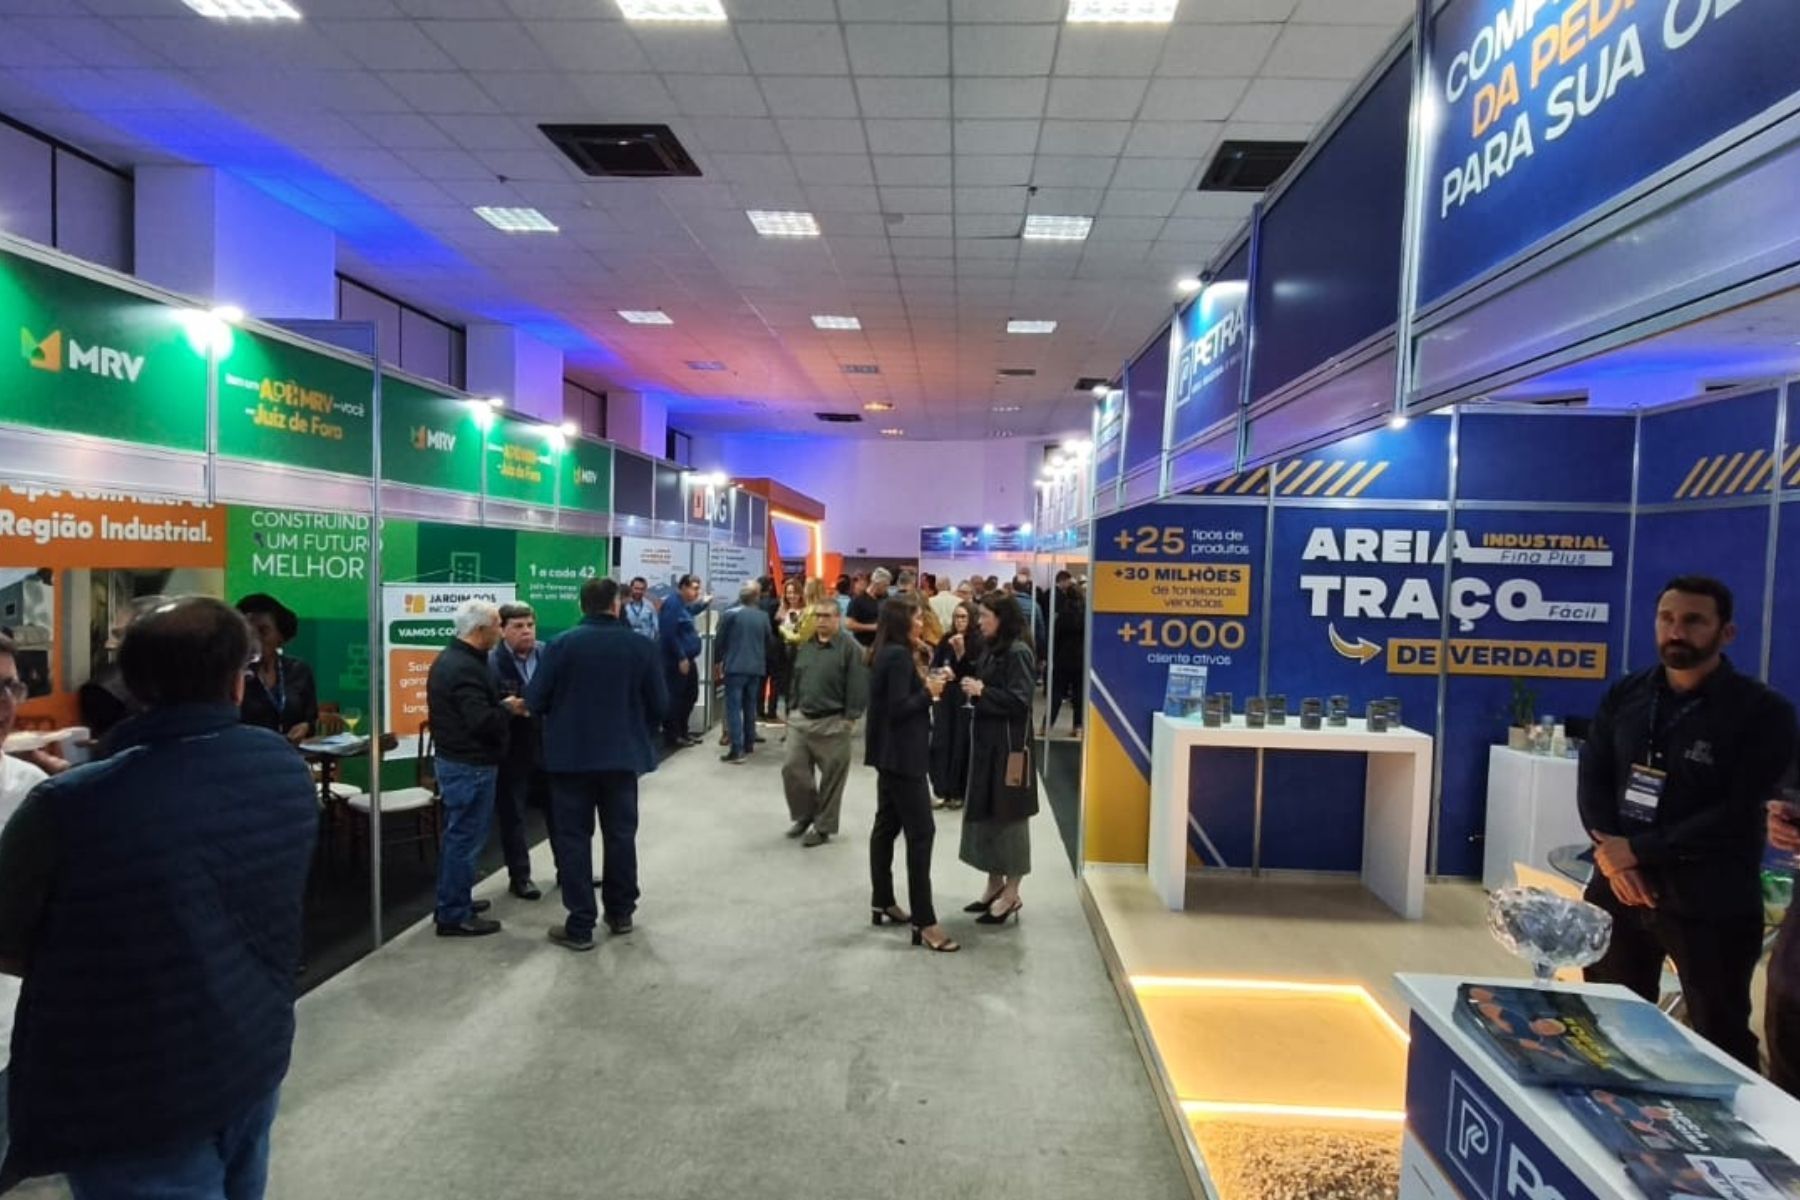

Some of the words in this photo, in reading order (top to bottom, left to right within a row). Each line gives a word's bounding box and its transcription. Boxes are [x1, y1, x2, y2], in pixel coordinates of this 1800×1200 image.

[1472, 61, 1520, 138] DA
[1441, 110, 1534, 218] PARA
[1545, 23, 1645, 141] SUA
[69, 339, 145, 382] MRV
[288, 411, 308, 433] de
[310, 415, 343, 439] Fora
[427, 429, 456, 451] MRV
[0, 508, 94, 544] Região
[100, 514, 213, 543] Industrial.
[266, 533, 299, 550] UM
[1114, 526, 1185, 555] +25
[1225, 529, 1244, 541] de
[1191, 543, 1249, 555] produtos
[1302, 527, 1471, 565] AREIA
[1483, 533, 1610, 549] INDUSTRIAL
[251, 553, 366, 580] MELHOR
[1500, 550, 1540, 564] Fina
[1547, 550, 1586, 565] Plus
[529, 563, 537, 577] 1
[579, 565, 596, 578] 42
[1114, 567, 1149, 580] +30
[1155, 565, 1241, 583] MILHÕES
[1151, 586, 1169, 595] de
[1172, 585, 1237, 597] toneladas
[1300, 574, 1543, 632] TRAÇO
[1164, 598, 1224, 609] vendidas
[398, 626, 435, 637] VAMOS
[1117, 619, 1246, 649] +1000
[1396, 645, 1437, 665] DE
[1451, 646, 1597, 669] VERDADE
